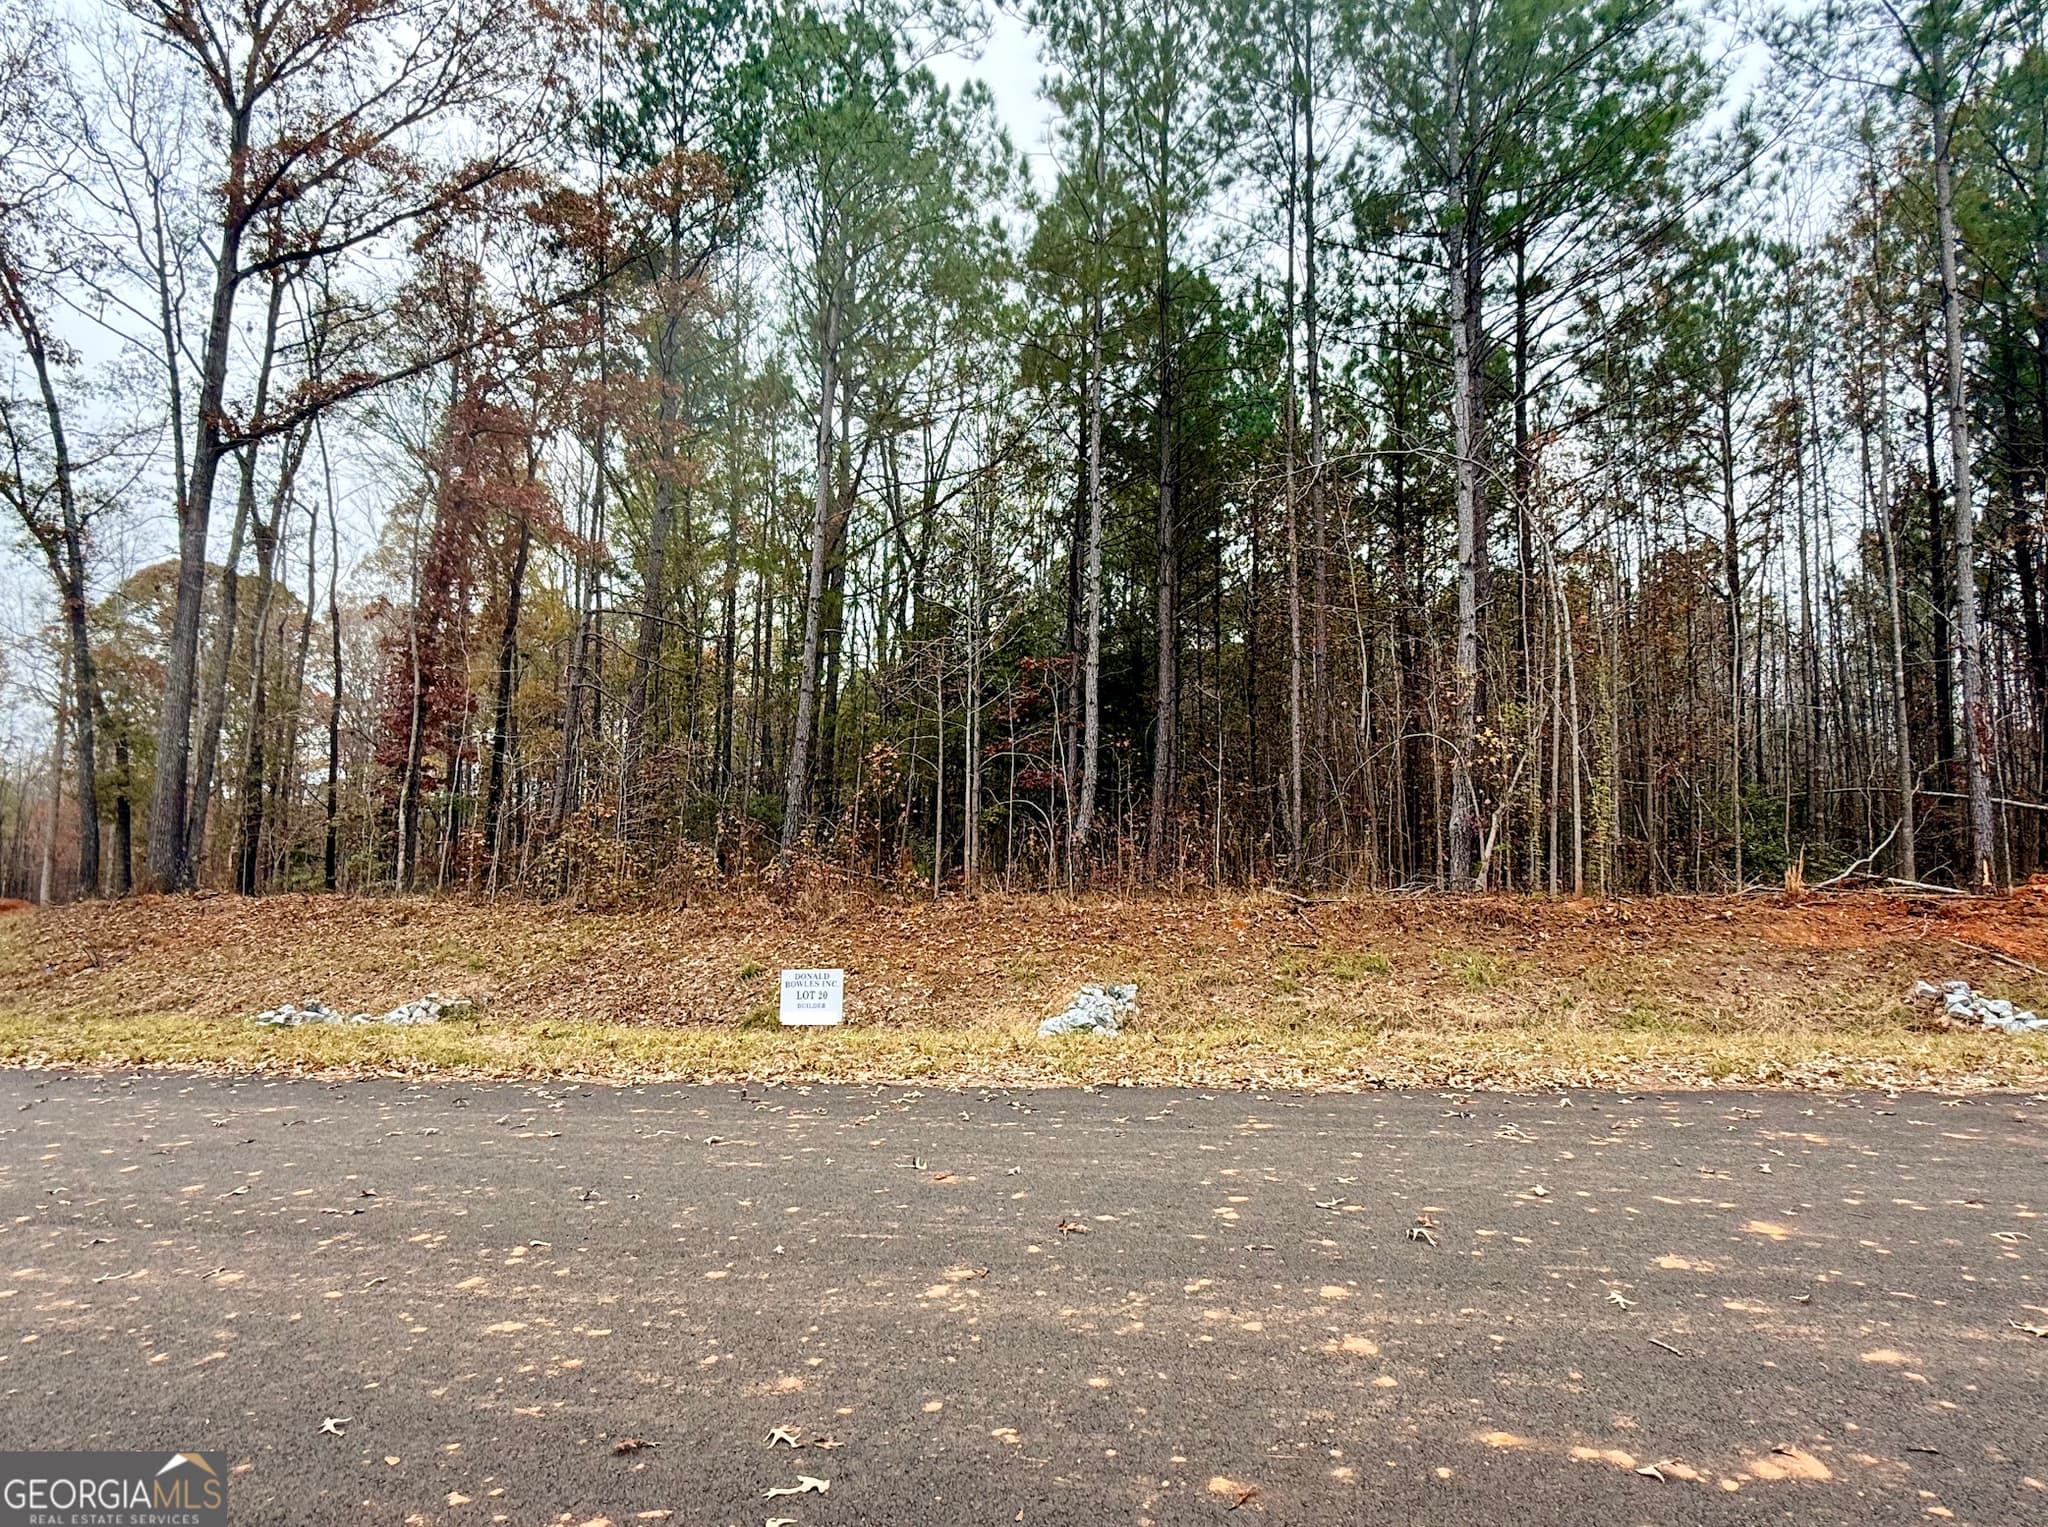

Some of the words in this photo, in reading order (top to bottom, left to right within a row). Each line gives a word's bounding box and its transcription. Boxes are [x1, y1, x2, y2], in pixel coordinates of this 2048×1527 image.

[785, 980, 820, 988] BOWLES
[796, 991, 816, 1000] LOT
[818, 990, 828, 1000] 20
